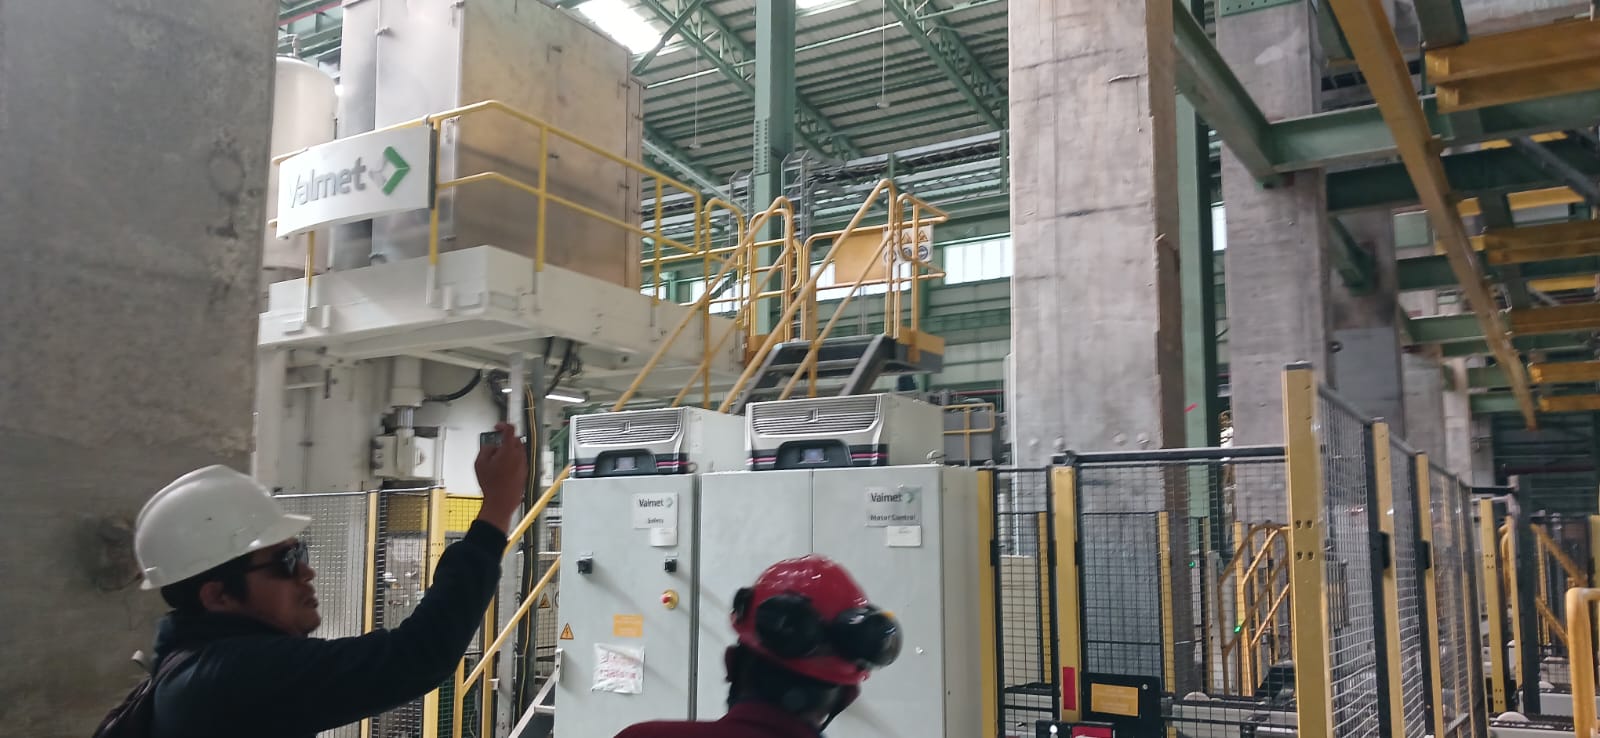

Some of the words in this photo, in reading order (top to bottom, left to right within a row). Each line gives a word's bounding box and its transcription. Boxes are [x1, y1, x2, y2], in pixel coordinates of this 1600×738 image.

[289, 156, 367, 209] Valmet
[638, 498, 664, 508] Valmet
[870, 491, 902, 503] Valmet
